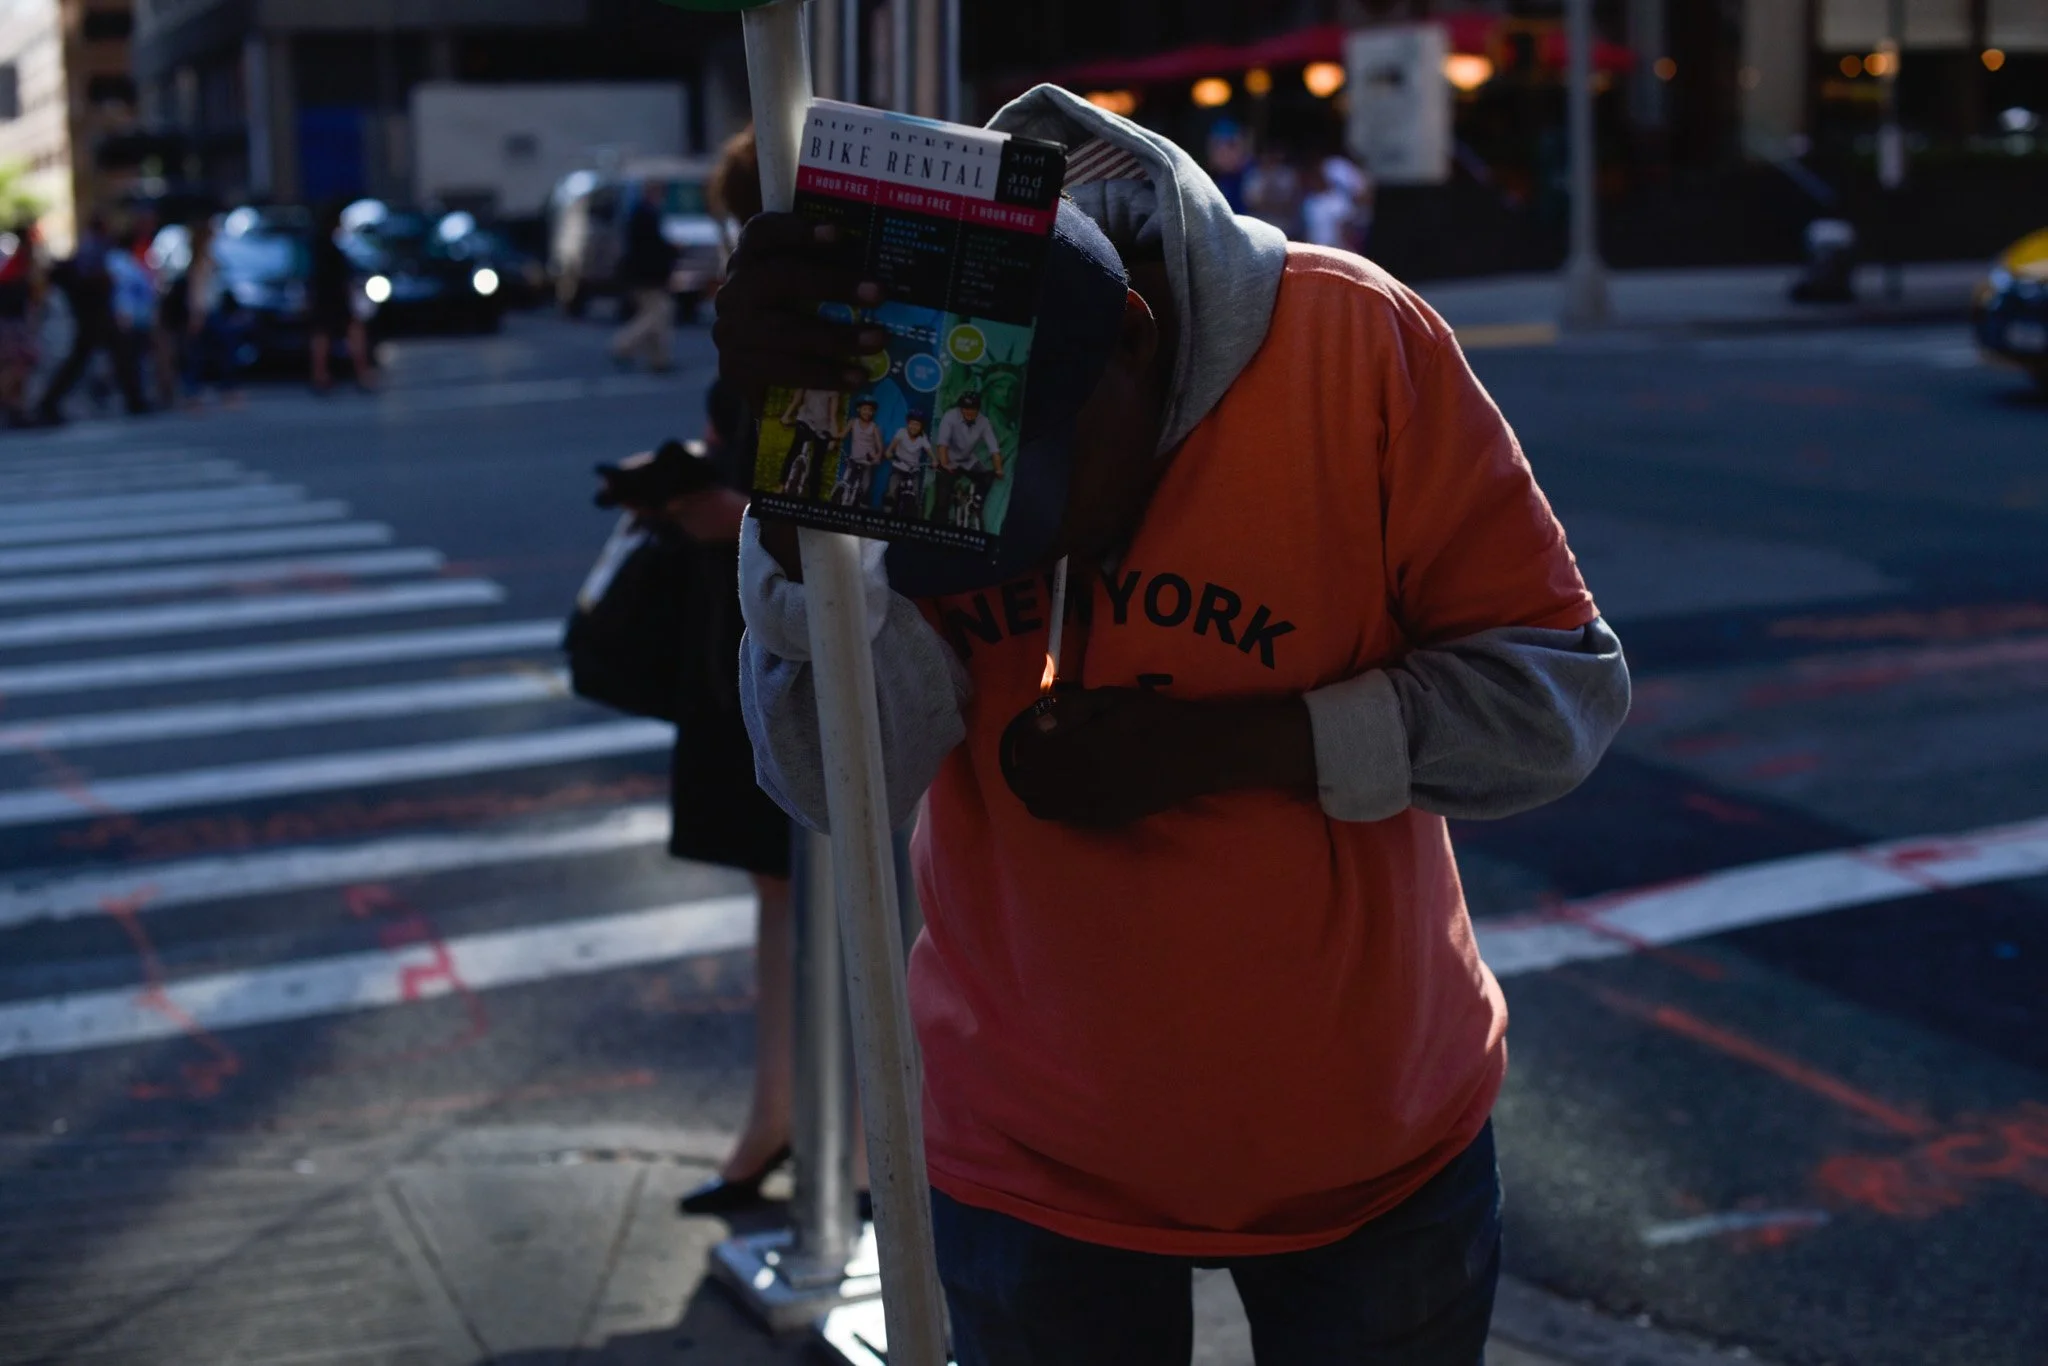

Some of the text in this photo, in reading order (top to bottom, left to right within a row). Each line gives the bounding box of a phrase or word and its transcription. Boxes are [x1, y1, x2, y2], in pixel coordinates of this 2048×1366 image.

[811, 136, 872, 168] BIKE
[886, 150, 984, 189] RENTAL
[807, 173, 869, 197] 1 HOUR FREE
[1008, 172, 1043, 188] and
[888, 189, 953, 212] 1 HOUR FREE
[971, 204, 1036, 228] 1 HOUR FREE
[761, 497, 804, 511] PRESENT
[808, 505, 829, 516] THIS
[833, 509, 862, 522] FLYER
[865, 516, 886, 527] AND
[1100, 570, 1297, 670] YORK
